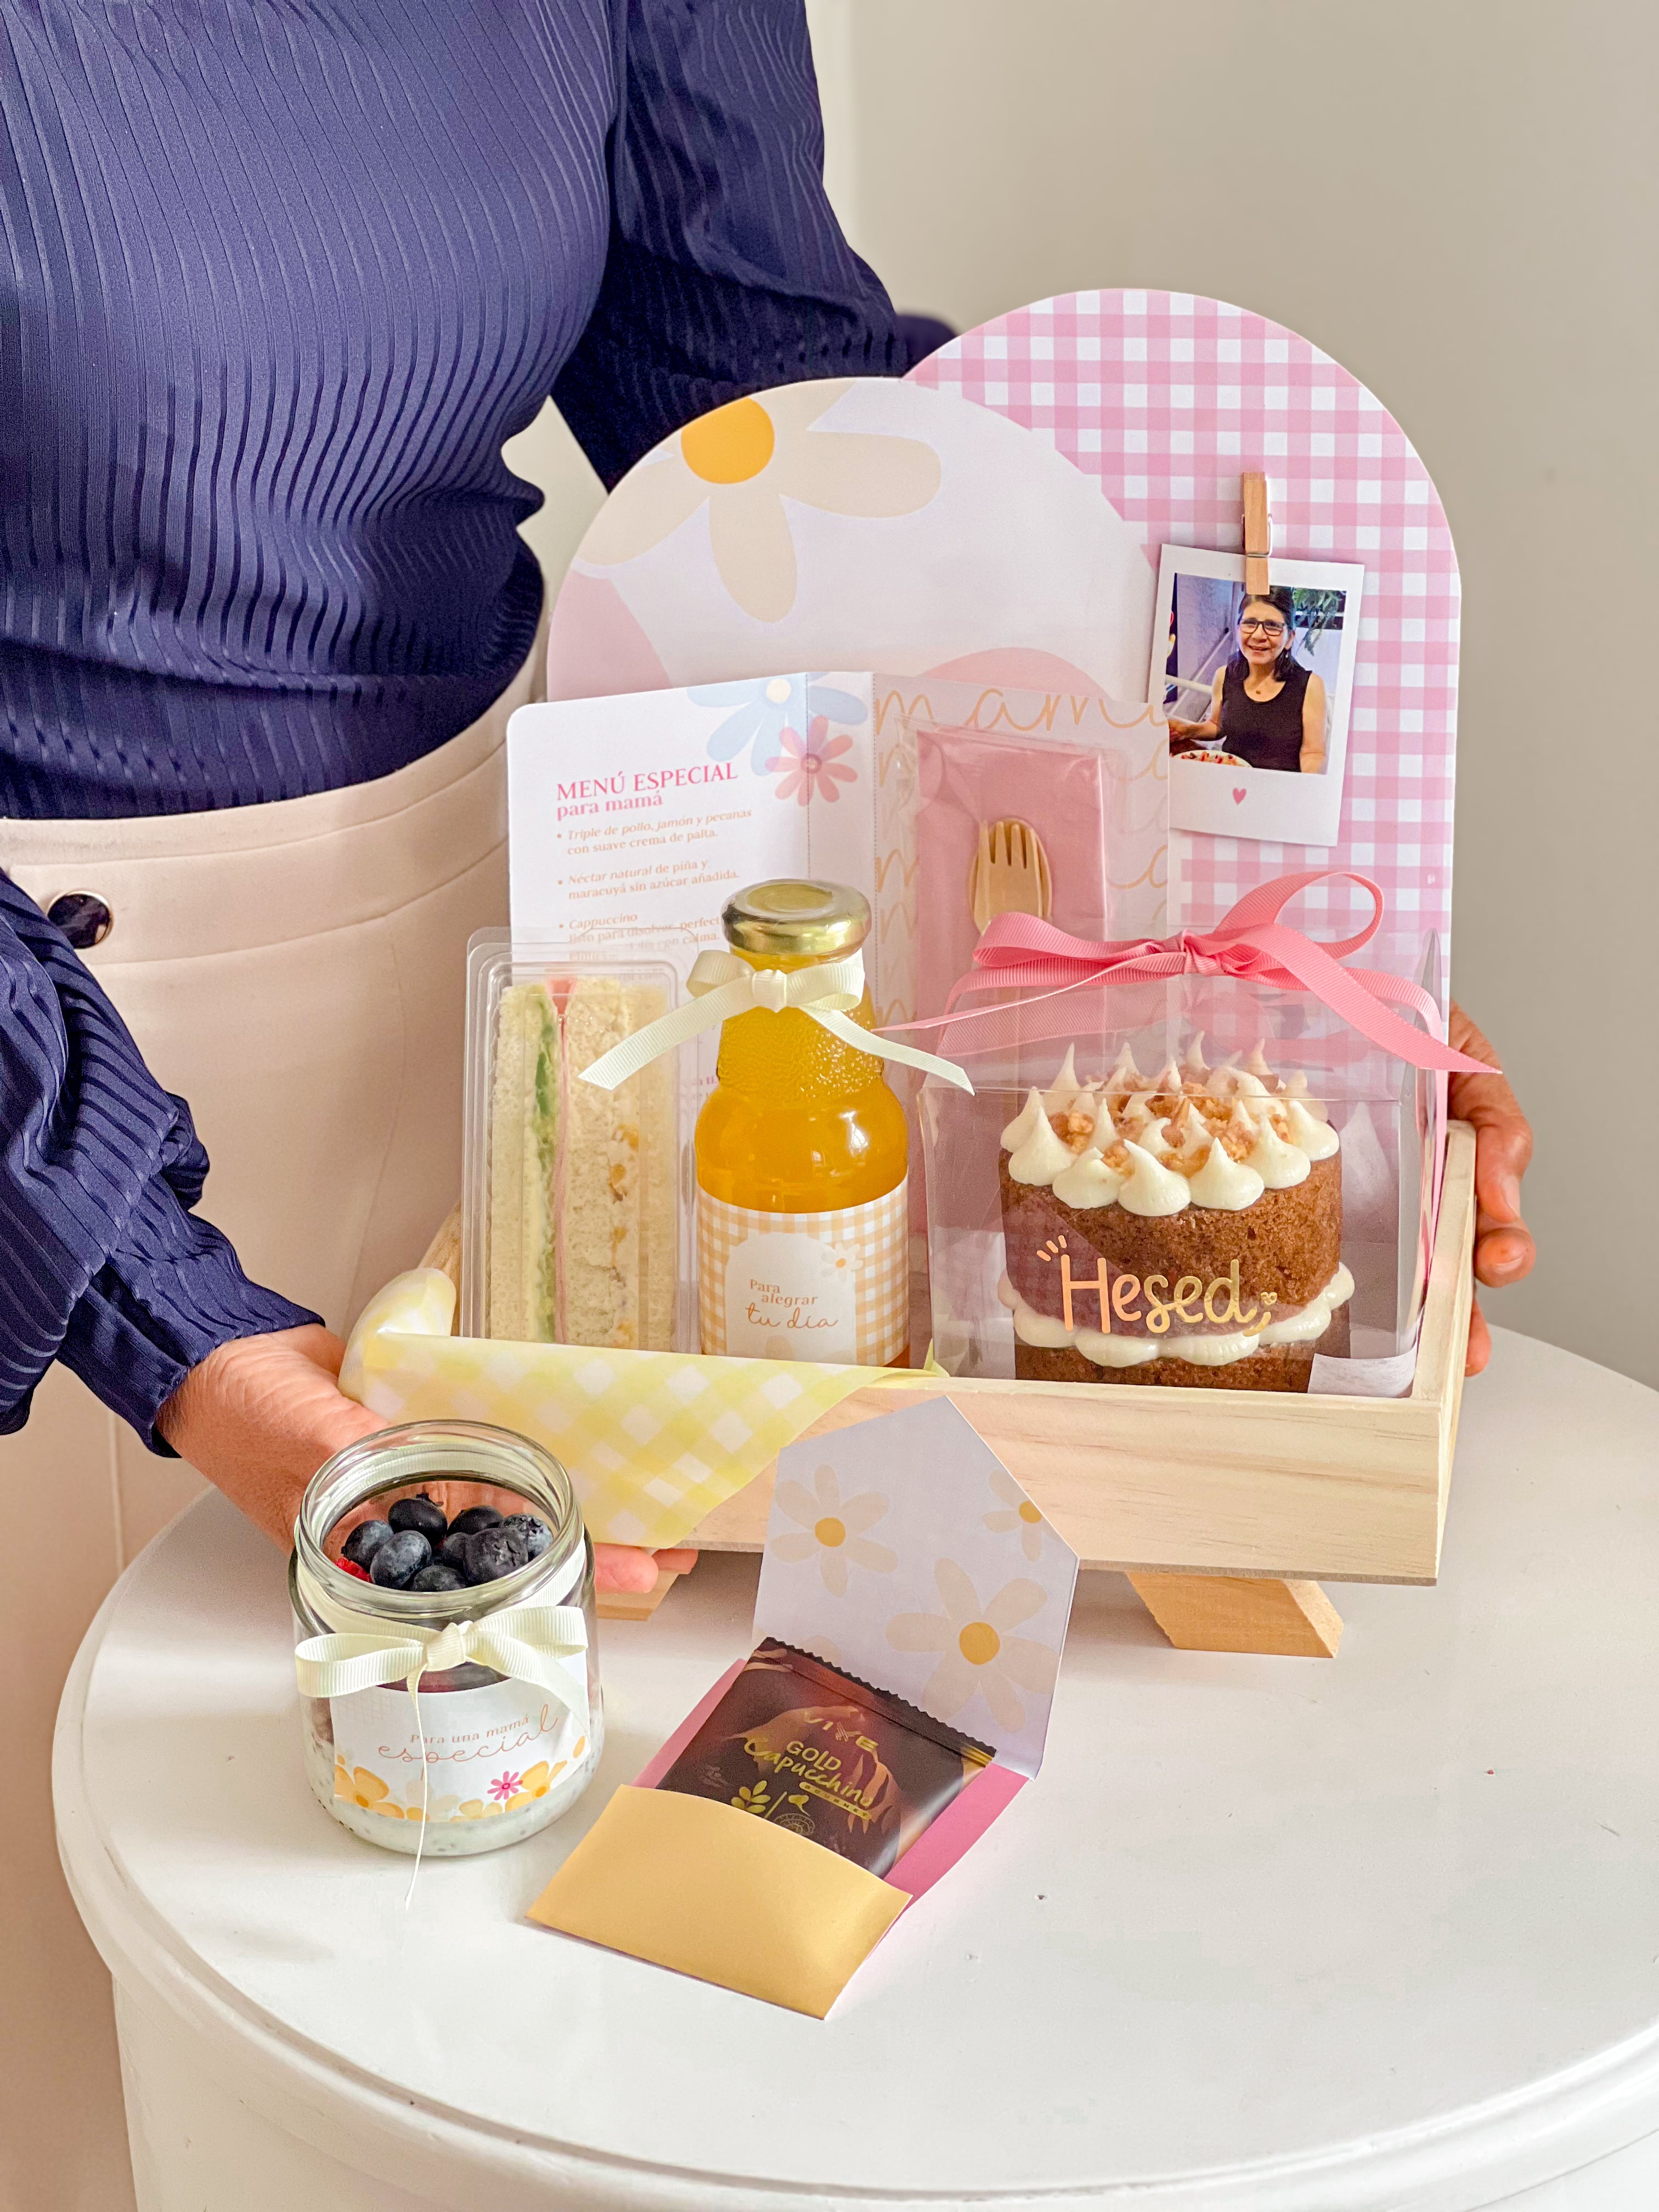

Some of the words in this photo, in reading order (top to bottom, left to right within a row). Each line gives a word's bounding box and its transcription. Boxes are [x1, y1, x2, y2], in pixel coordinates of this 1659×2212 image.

[557, 771, 626, 801] MENÚ
[633, 762, 739, 792] ESPECIAL
[557, 801, 599, 821] para
[605, 791, 663, 812] mamá
[568, 827, 602, 841] Triple
[604, 825, 619, 836] de
[622, 822, 654, 836] pollo,
[657, 815, 693, 832] jamón
[696, 817, 704, 827] y
[705, 808, 753, 825] pecanas
[567, 845, 590, 855] con
[592, 841, 627, 853] suave
[629, 836, 667, 849] crema
[669, 831, 684, 843] de
[686, 828, 718, 843] palta.
[568, 871, 607, 885] Néctar
[610, 865, 652, 880] natural
[655, 865, 670, 874] de
[672, 860, 698, 876] piña
[701, 860, 708, 872] y
[568, 885, 627, 900] maracuyá
[629, 881, 647, 892] sin
[649, 876, 688, 890] azúcar
[691, 868, 740, 884] añadida.
[569, 912, 638, 929] Cappuccino
[597, 929, 625, 943] para
[680, 915, 720, 932] perfect
[682, 932, 720, 945] calma.
[749, 1279, 781, 1294] Para
[761, 1293, 819, 1308] alegrar
[1060, 1254, 1257, 1334] Hesed
[744, 1302, 781, 1327] tu
[378, 1703, 558, 1781] especial
[451, 1733, 479, 1743] una
[486, 1714, 530, 1738] mamá
[786, 1740, 842, 1771] GOLD
